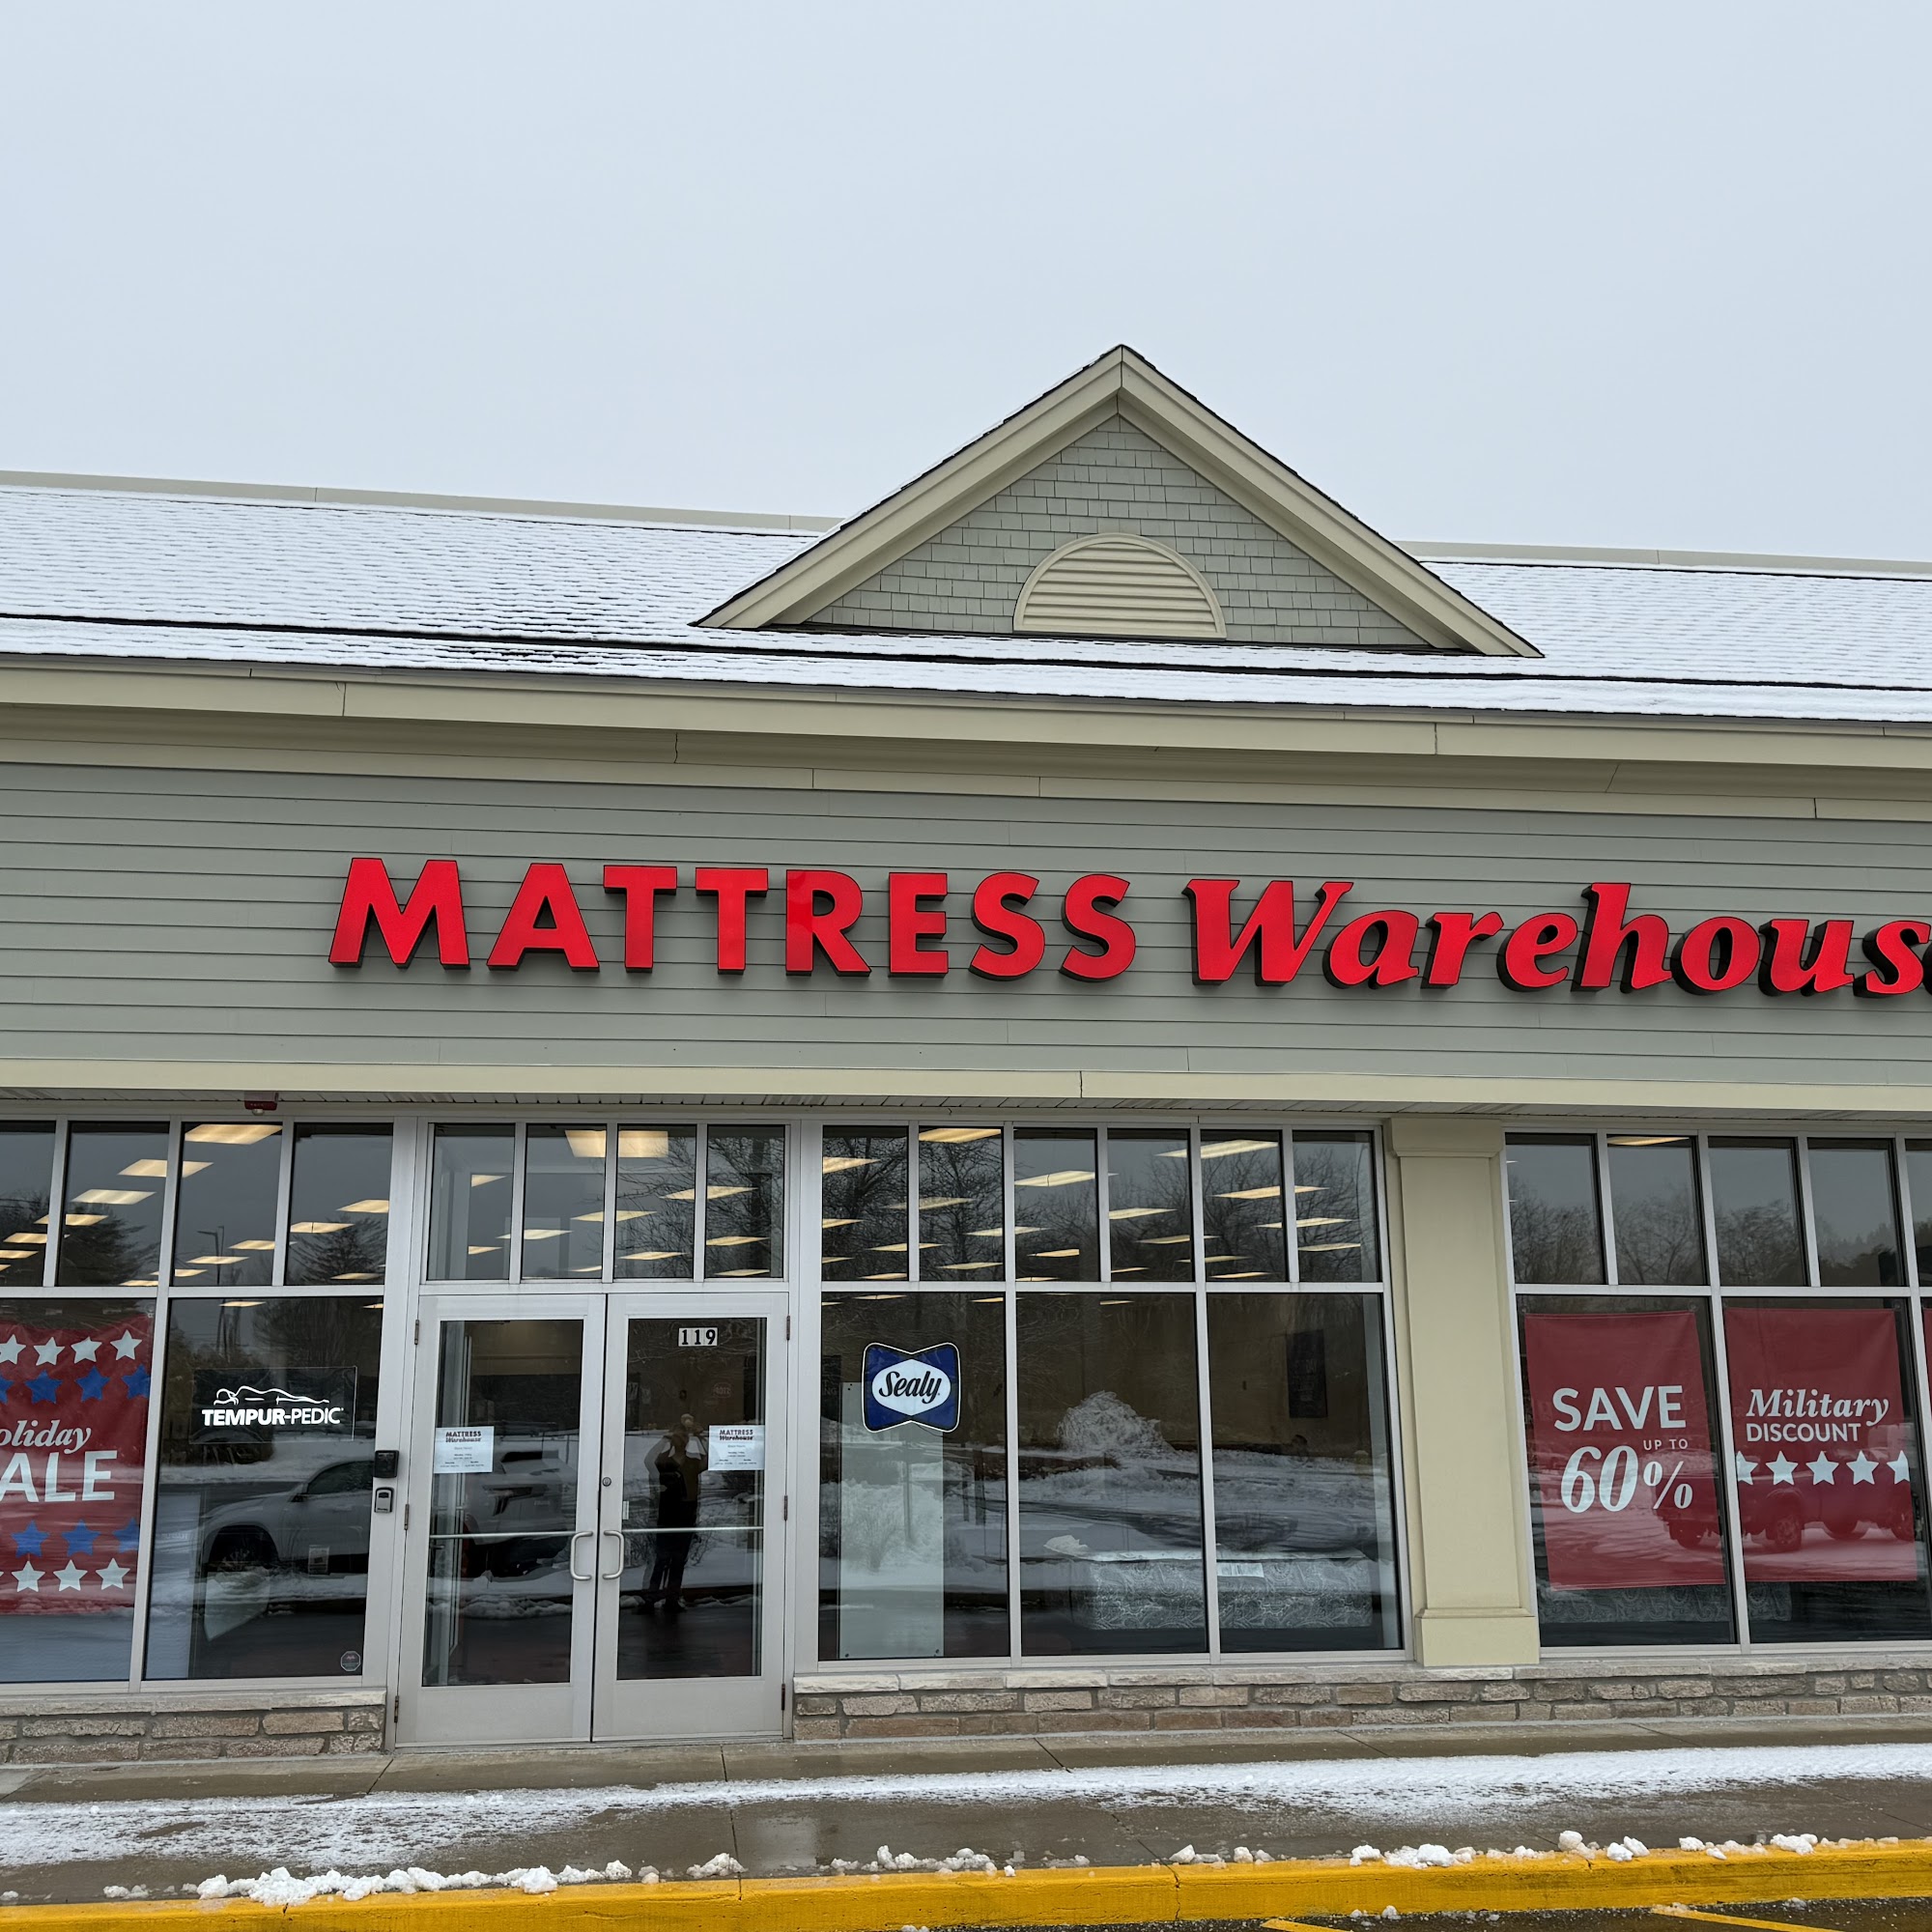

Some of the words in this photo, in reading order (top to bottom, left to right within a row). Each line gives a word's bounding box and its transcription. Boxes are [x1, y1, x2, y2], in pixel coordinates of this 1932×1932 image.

[328, 857, 1137, 983] MATTRESS
[1182, 879, 1932, 999] Warehous
[682, 1328, 716, 1346] 119
[878, 1370, 943, 1405] Sealy
[201, 1406, 341, 1427] TEMPUR-PEDIC
[1551, 1384, 1688, 1433] SAVE
[1746, 1388, 1889, 1427] Military
[1643, 1438, 1662, 1451] UP
[1669, 1438, 1689, 1450] TO
[1746, 1422, 1861, 1443] DISCOUNT
[1560, 1444, 1693, 1514] 60%
